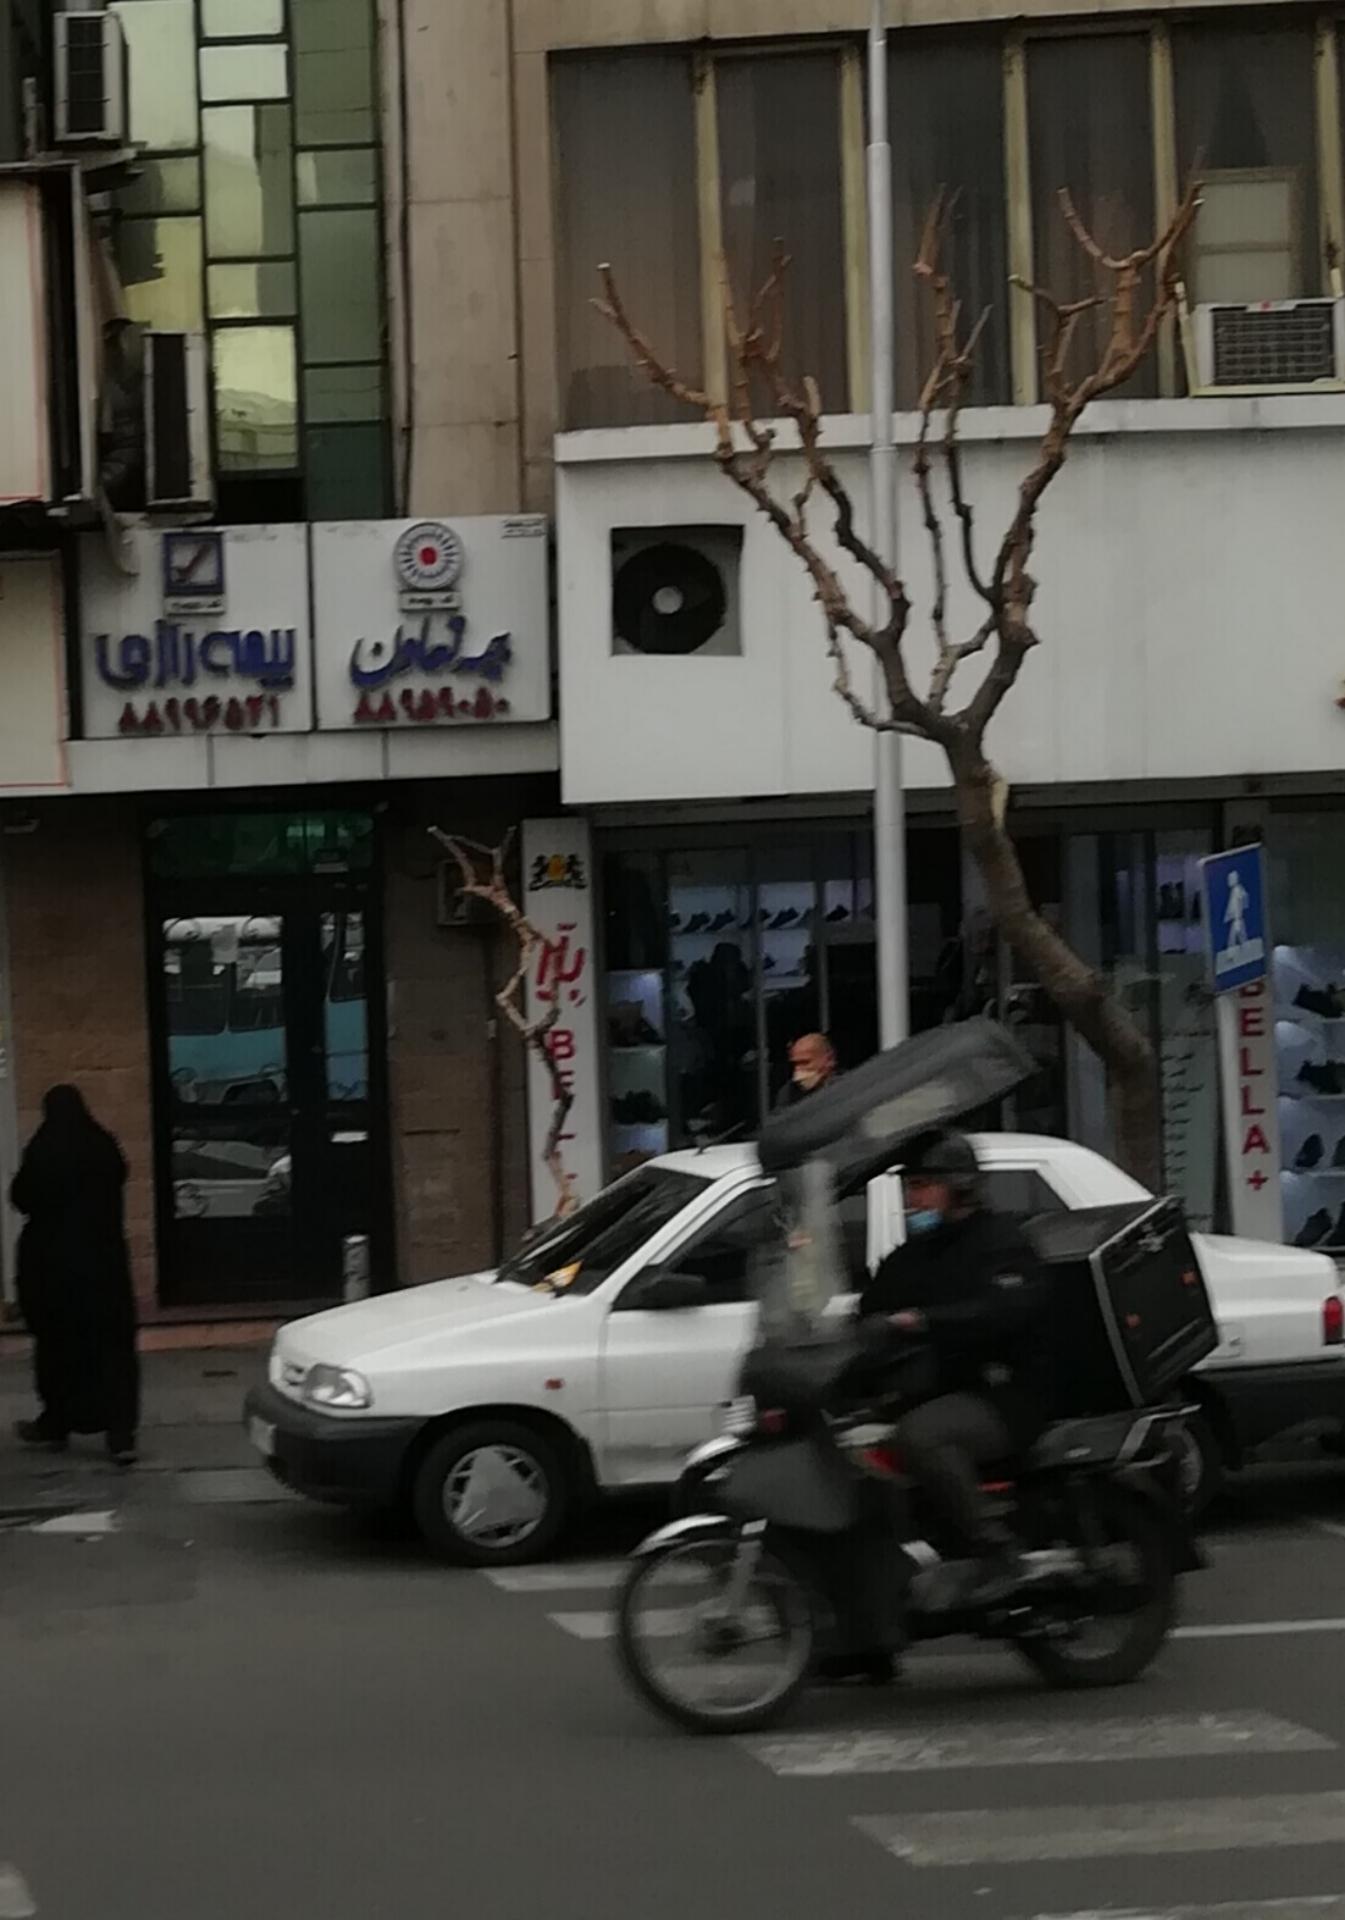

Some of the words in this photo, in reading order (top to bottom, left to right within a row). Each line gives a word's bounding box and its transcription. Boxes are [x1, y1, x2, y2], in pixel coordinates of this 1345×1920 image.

[95, 618, 196, 692] رازی
[200, 628, 297, 692] بیمه
[349, 613, 467, 690] تعاون
